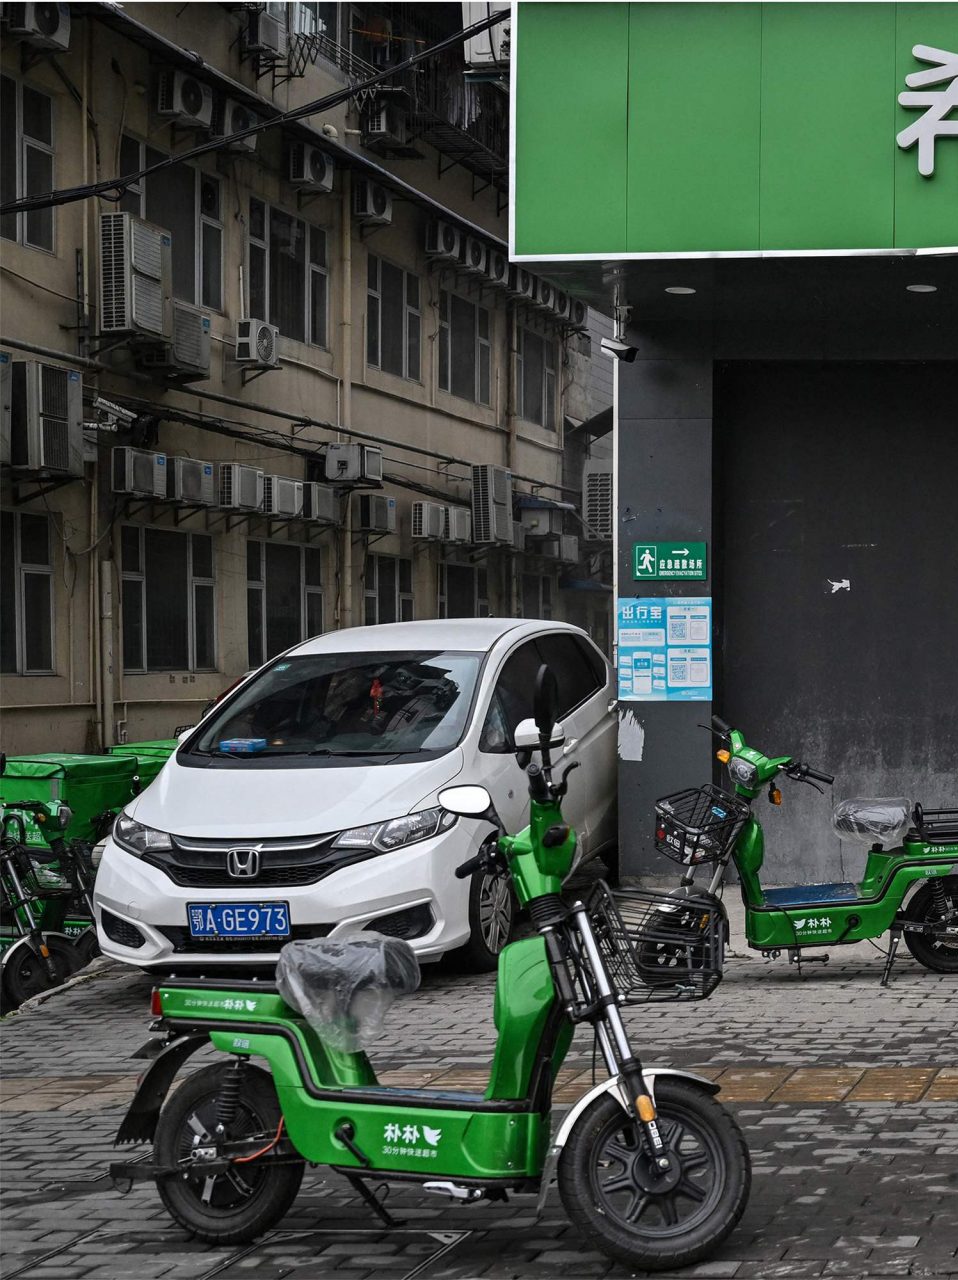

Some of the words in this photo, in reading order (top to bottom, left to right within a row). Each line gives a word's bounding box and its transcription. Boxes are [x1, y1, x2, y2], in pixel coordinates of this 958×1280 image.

[659, 559, 703, 570] 应急疏散场所
[622, 606, 662, 619] 出行宝
[191, 908, 287, 931] 鄂A·GE973
[807, 917, 832, 928] 朴朴
[383, 1123, 420, 1145] 朴朴
[382, 1145, 438, 1158] 30分钟快送超市
